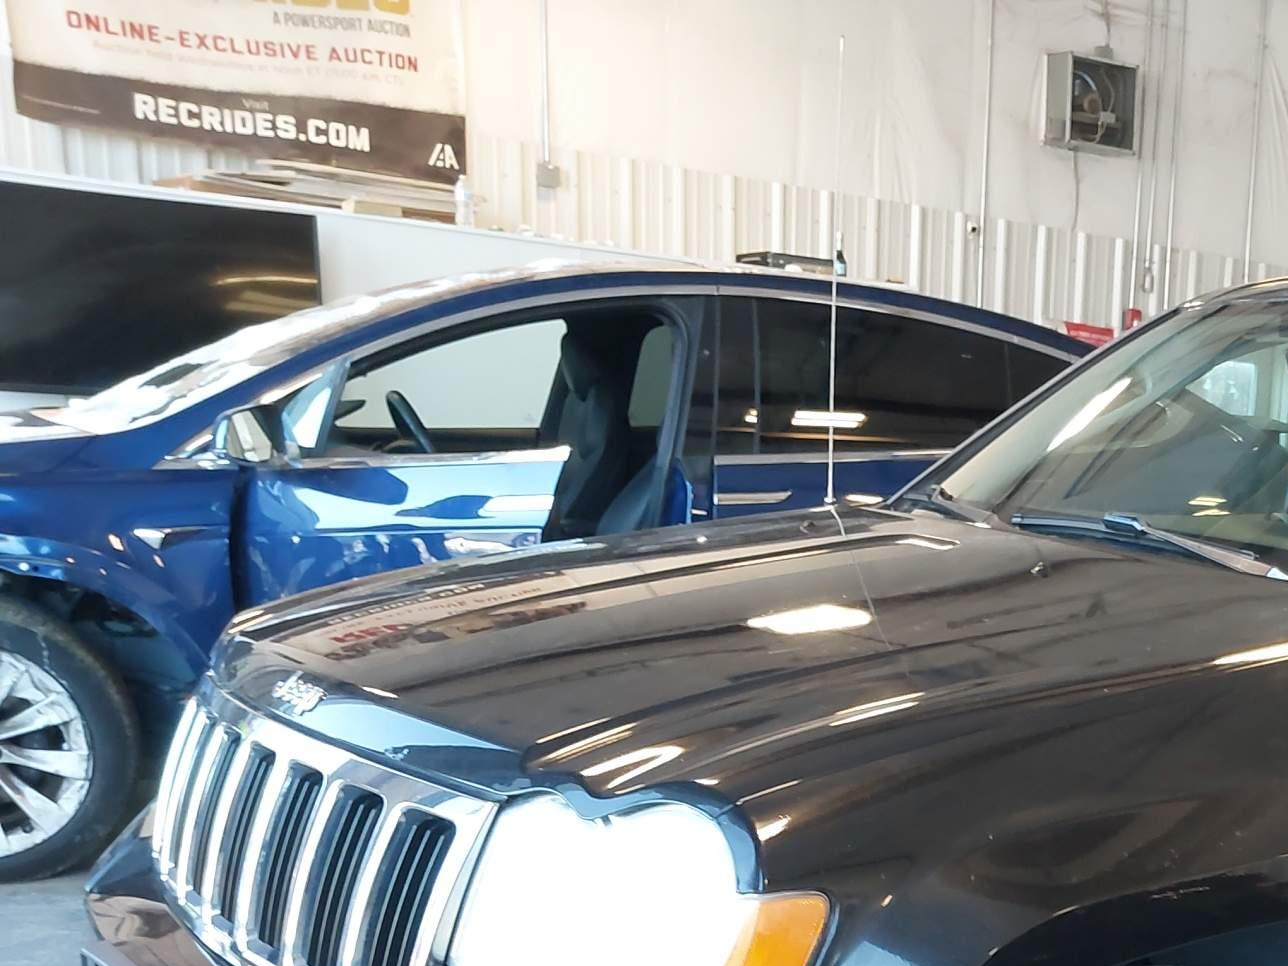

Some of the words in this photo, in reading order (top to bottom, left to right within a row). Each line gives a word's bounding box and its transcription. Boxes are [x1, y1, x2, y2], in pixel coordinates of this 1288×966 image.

[66, 10, 319, 61] ONLINE-EXCLUSIVE
[328, 47, 419, 72] AUCTION
[272, 11, 282, 25] A
[284, 12, 363, 32] POWERSPORT
[367, 19, 411, 38] AUCTION
[132, 92, 371, 153] RECRIDES.COM
